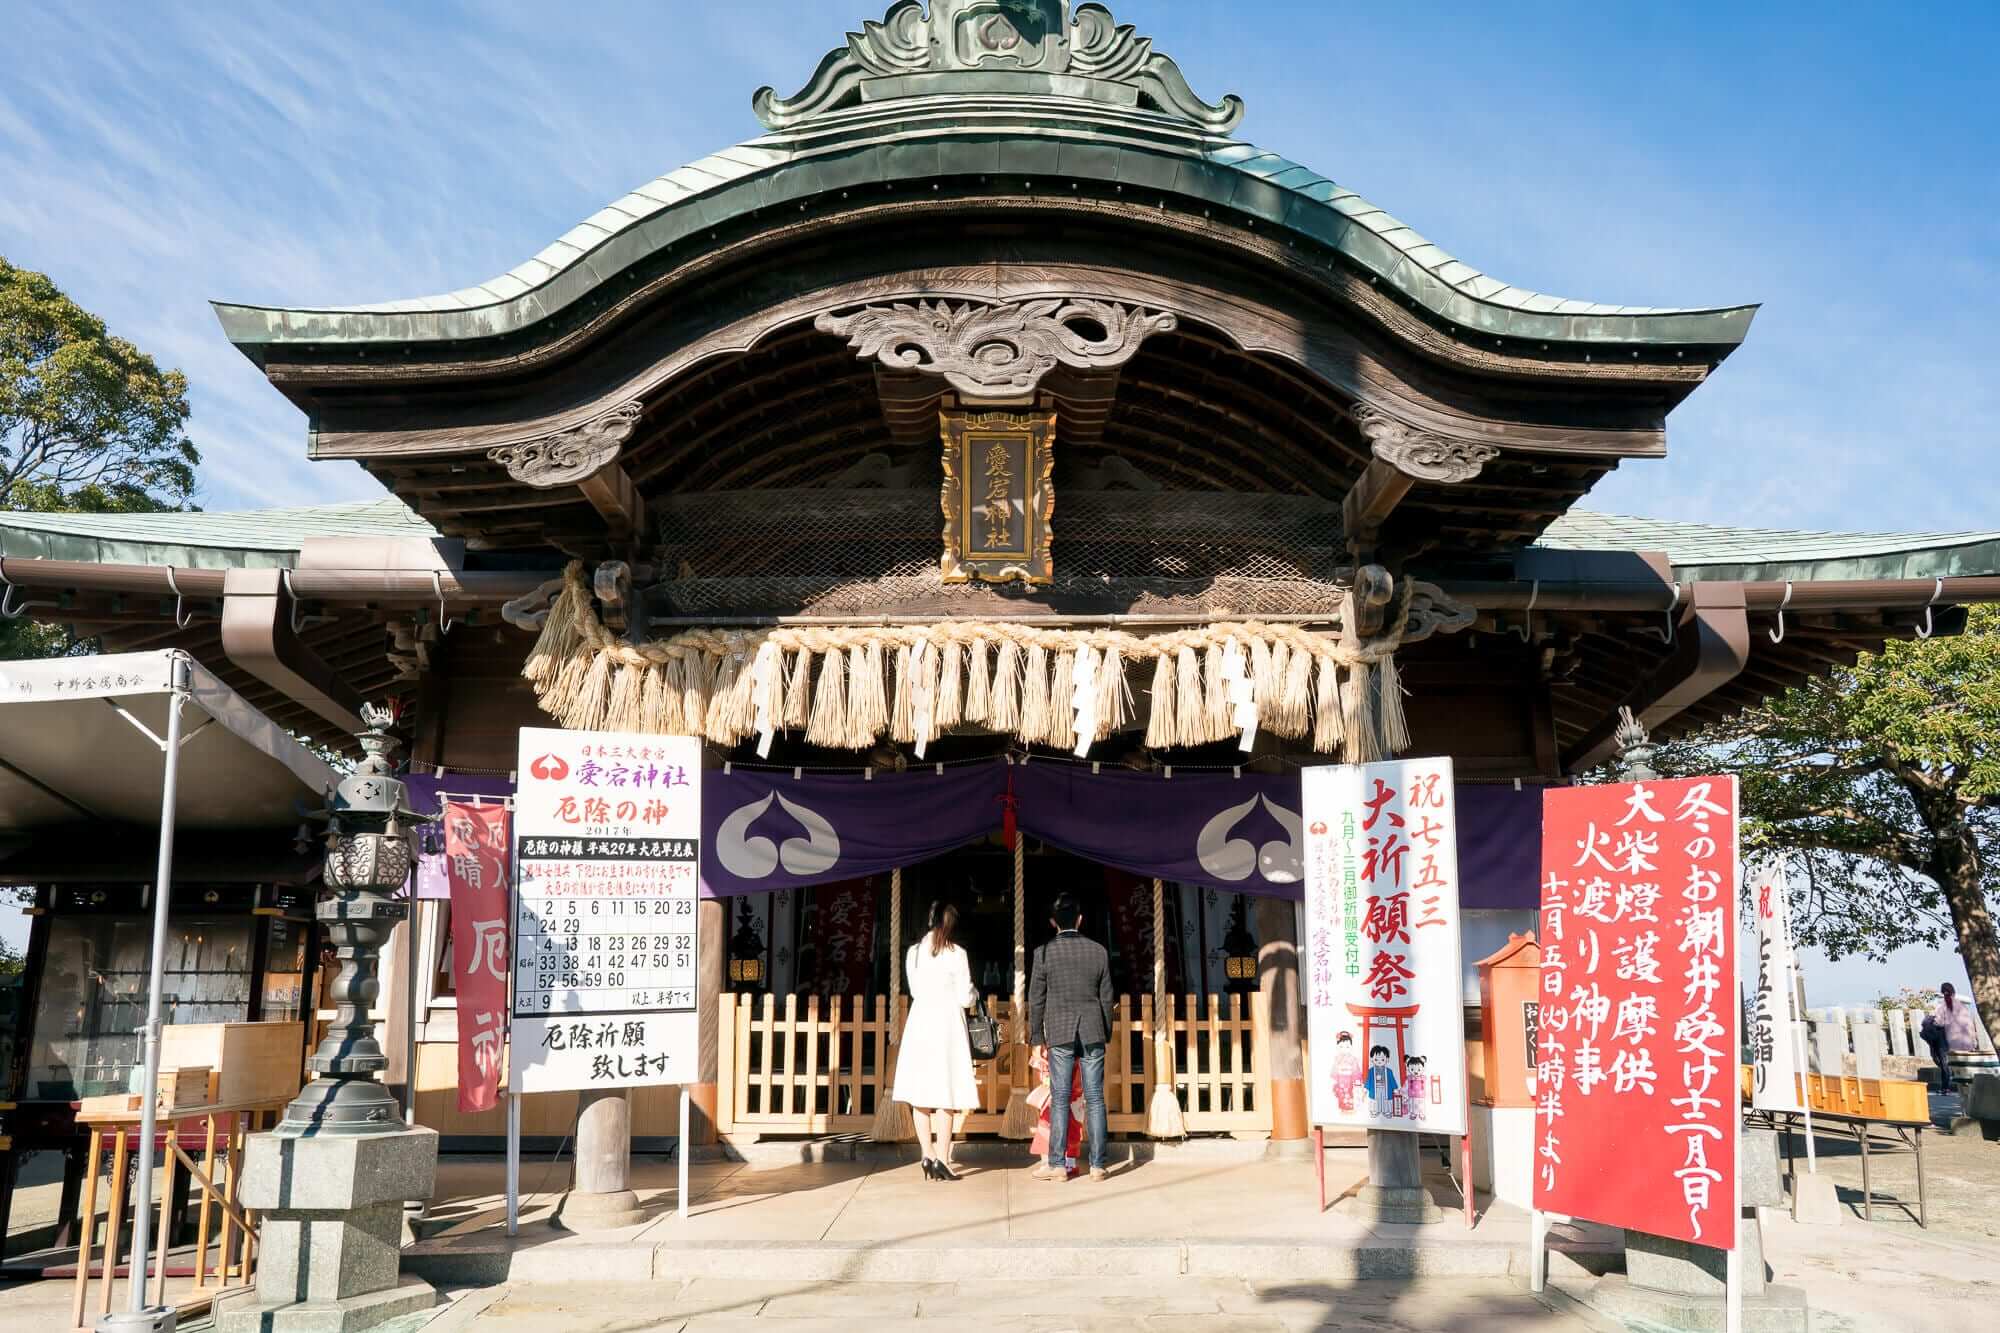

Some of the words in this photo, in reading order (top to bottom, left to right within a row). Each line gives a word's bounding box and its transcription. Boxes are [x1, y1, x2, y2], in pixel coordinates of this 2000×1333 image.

[984, 443, 1015, 548] 愛宕神社
[576, 760, 690, 789] 愛宕神社
[554, 796, 669, 825] 厄除の神
[585, 826, 631, 836] 2017年
[524, 842, 583, 856] 厄除の神様
[1409, 774, 1447, 928] 祝七五三
[1361, 778, 1416, 1003] 大祈願祭
[546, 901, 553, 915] 2
[569, 901, 575, 915] 5
[592, 901, 599, 915] 6
[612, 901, 623, 914] 11
[635, 901, 646, 914] 15
[655, 901, 669, 914] 20
[676, 901, 691, 914] 23
[540, 920, 556, 933] 24
[564, 919, 579, 933] 29
[1608, 784, 1666, 1095] 大柴燈護摩供
[544, 938, 552, 951] 4
[566, 937, 577, 951] 13
[589, 937, 600, 950] 18
[609, 937, 624, 950] 23
[632, 936, 647, 950] 26
[654, 936, 669, 950] 29
[676, 936, 690, 949] 32
[540, 956, 556, 970] 33
[563, 956, 579, 969] 38
[587, 956, 600, 969] 41
[609, 956, 624, 968] 42
[631, 955, 646, 968] 47
[653, 955, 669, 967] 50
[678, 954, 689, 967] 51
[1313, 928, 1333, 1007] 愛宕神社
[1570, 822, 1617, 1095] 火渡り神事
[539, 975, 555, 988] 52
[562, 974, 578, 987] 56
[586, 974, 601, 986] 59
[608, 973, 624, 986] 60
[542, 995, 550, 1009] 9
[541, 1021, 646, 1051] 厄除祈願
[591, 1053, 669, 1079] 致します
